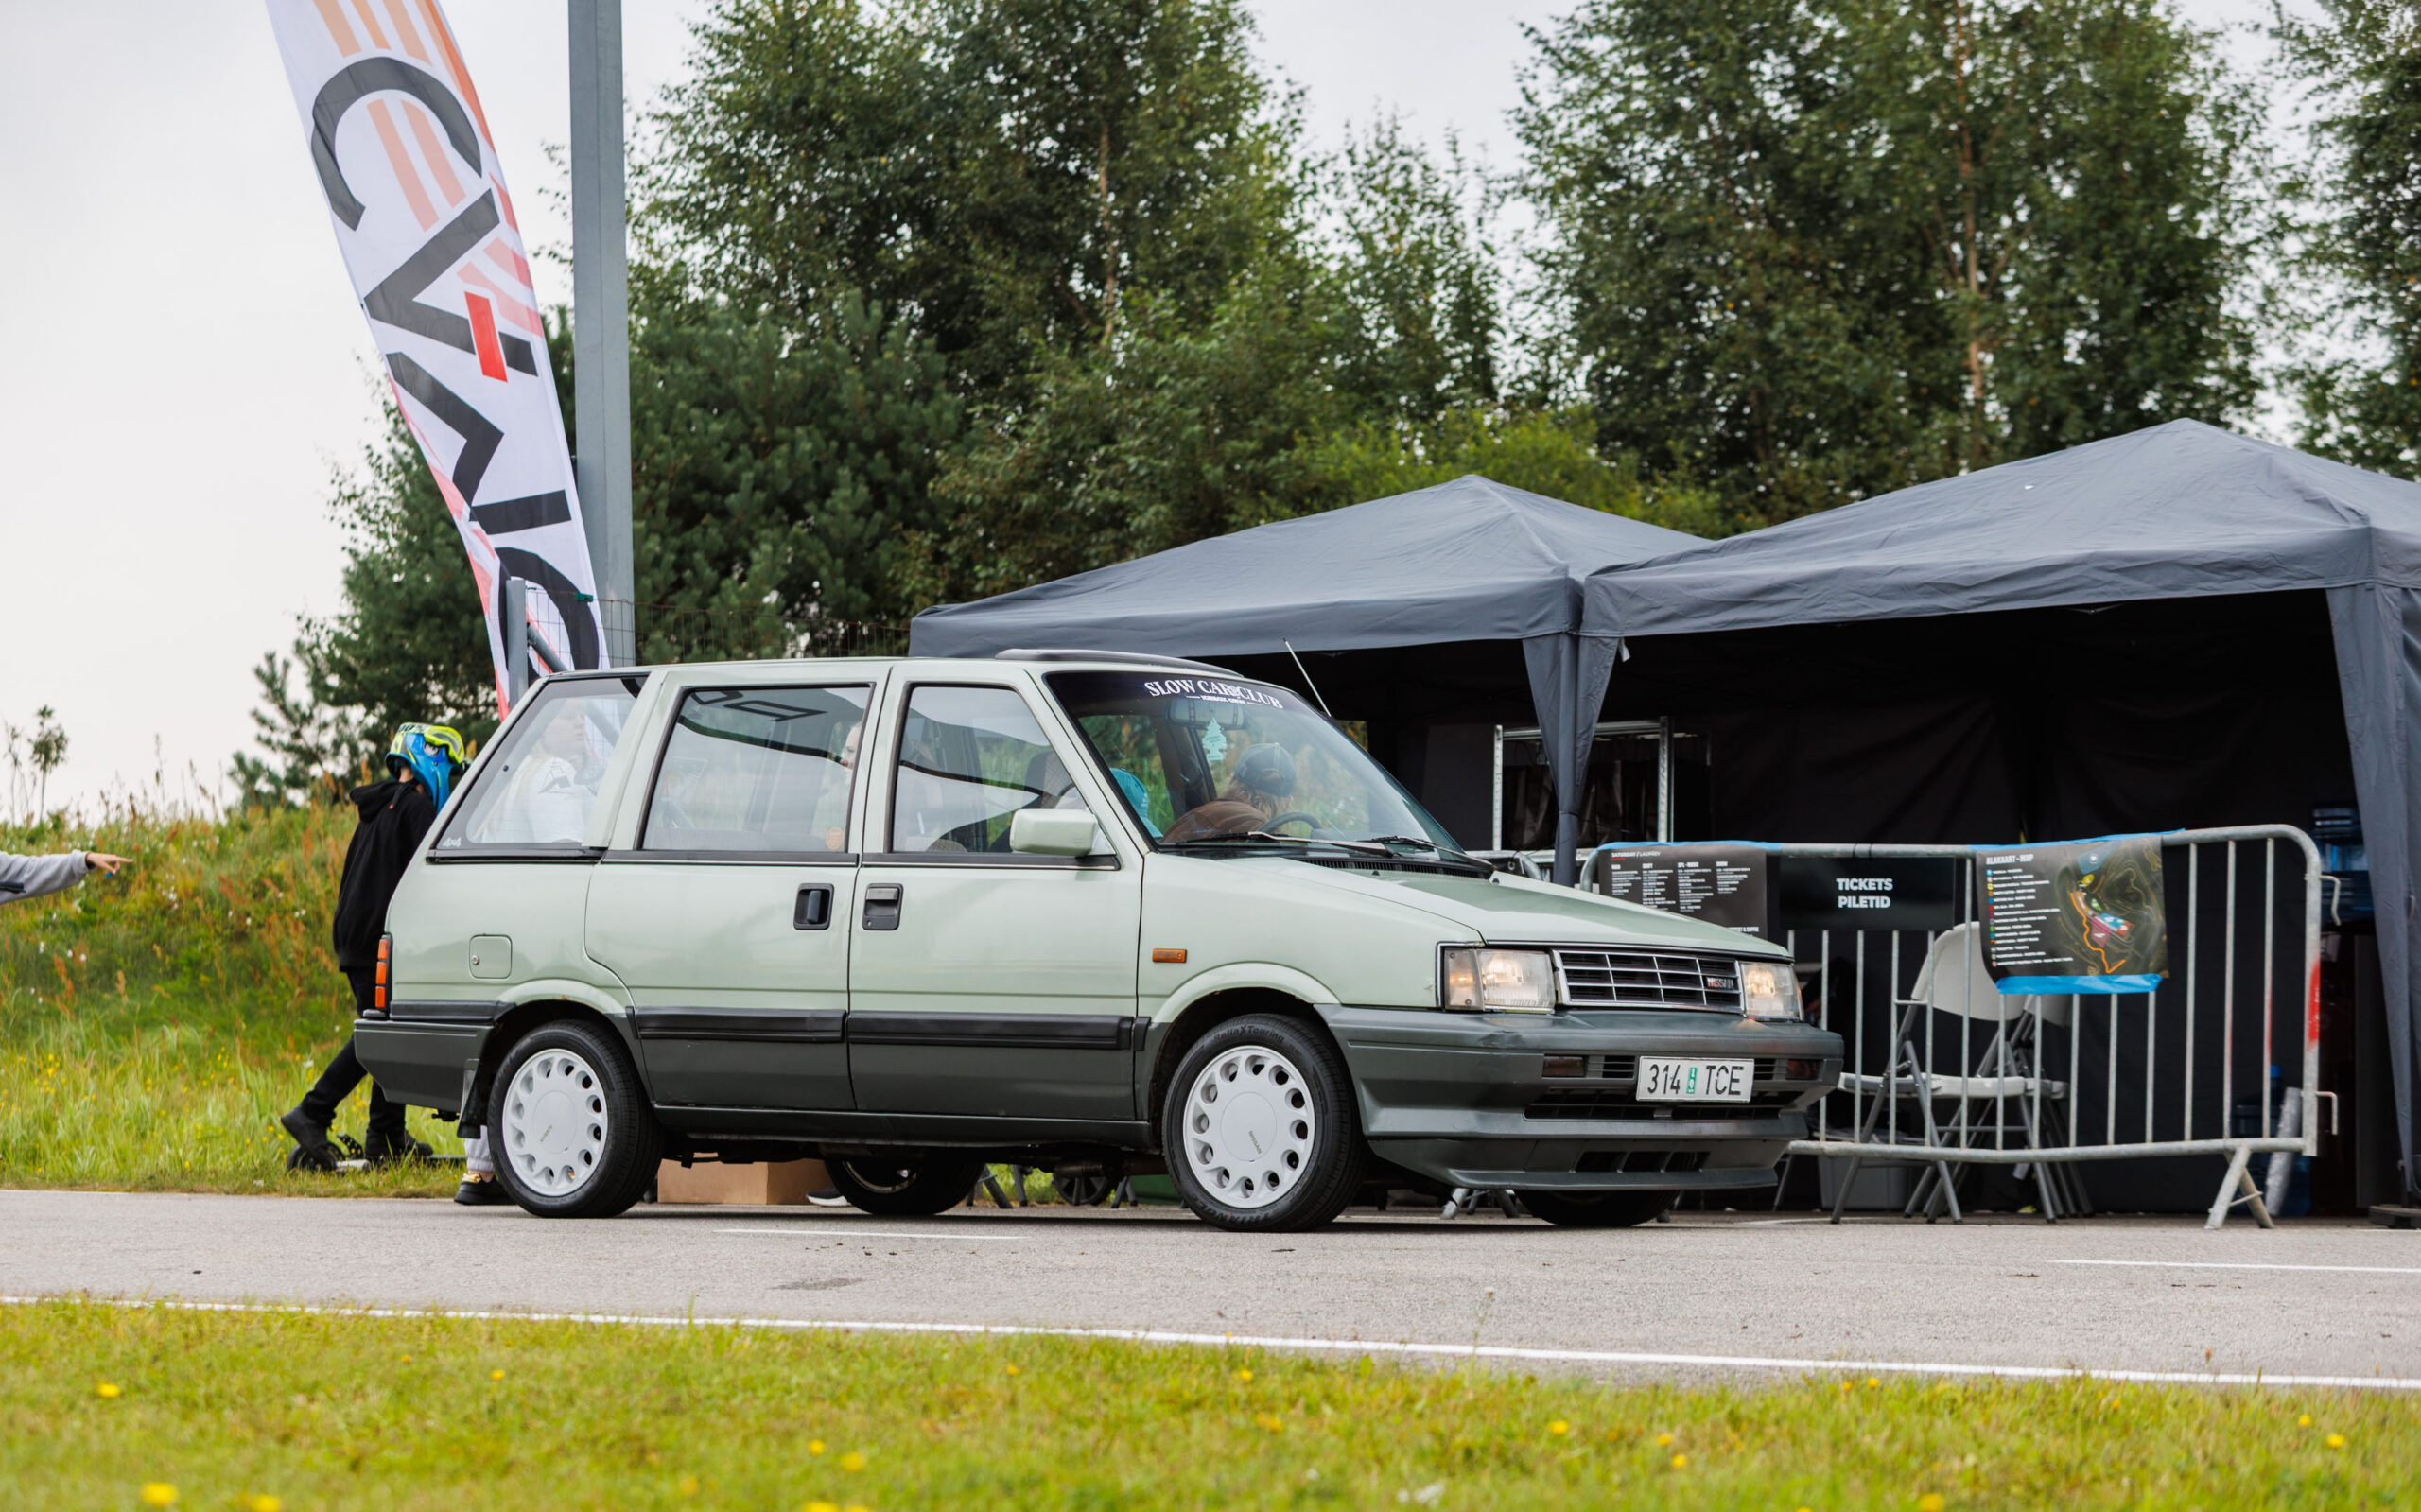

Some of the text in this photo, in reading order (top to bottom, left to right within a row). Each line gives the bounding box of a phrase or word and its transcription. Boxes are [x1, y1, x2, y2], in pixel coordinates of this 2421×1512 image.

[1144, 679, 1195, 697] SLOW
[1197, 680, 1233, 696] CAR
[1237, 686, 1283, 709] CLUB
[1836, 878, 1893, 891] TICKETS
[1838, 895, 1891, 908] PILETID
[1647, 1064, 1681, 1095] 314
[1705, 1065, 1744, 1096] TCE
